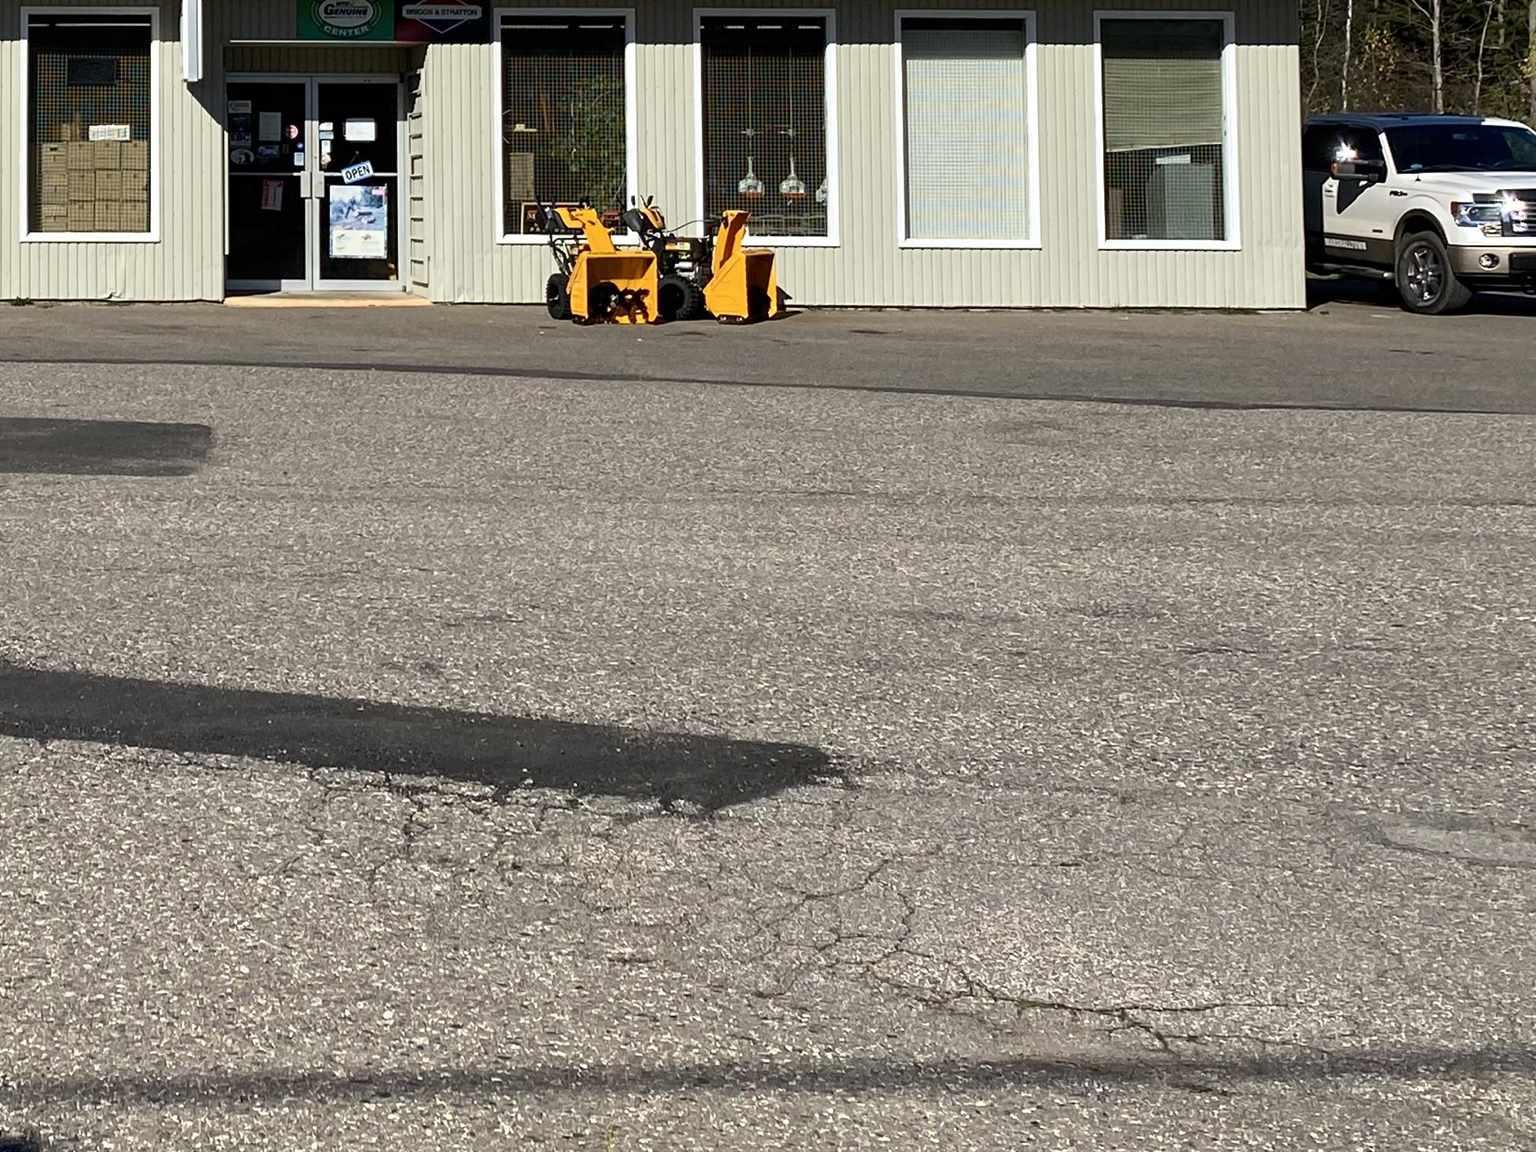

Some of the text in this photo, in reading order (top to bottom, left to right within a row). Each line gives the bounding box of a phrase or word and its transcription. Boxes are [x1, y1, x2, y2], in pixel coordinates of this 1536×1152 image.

[323, 3, 369, 16] GENUINE
[323, 25, 369, 37] CENTER
[345, 165, 370, 181] OPEN
